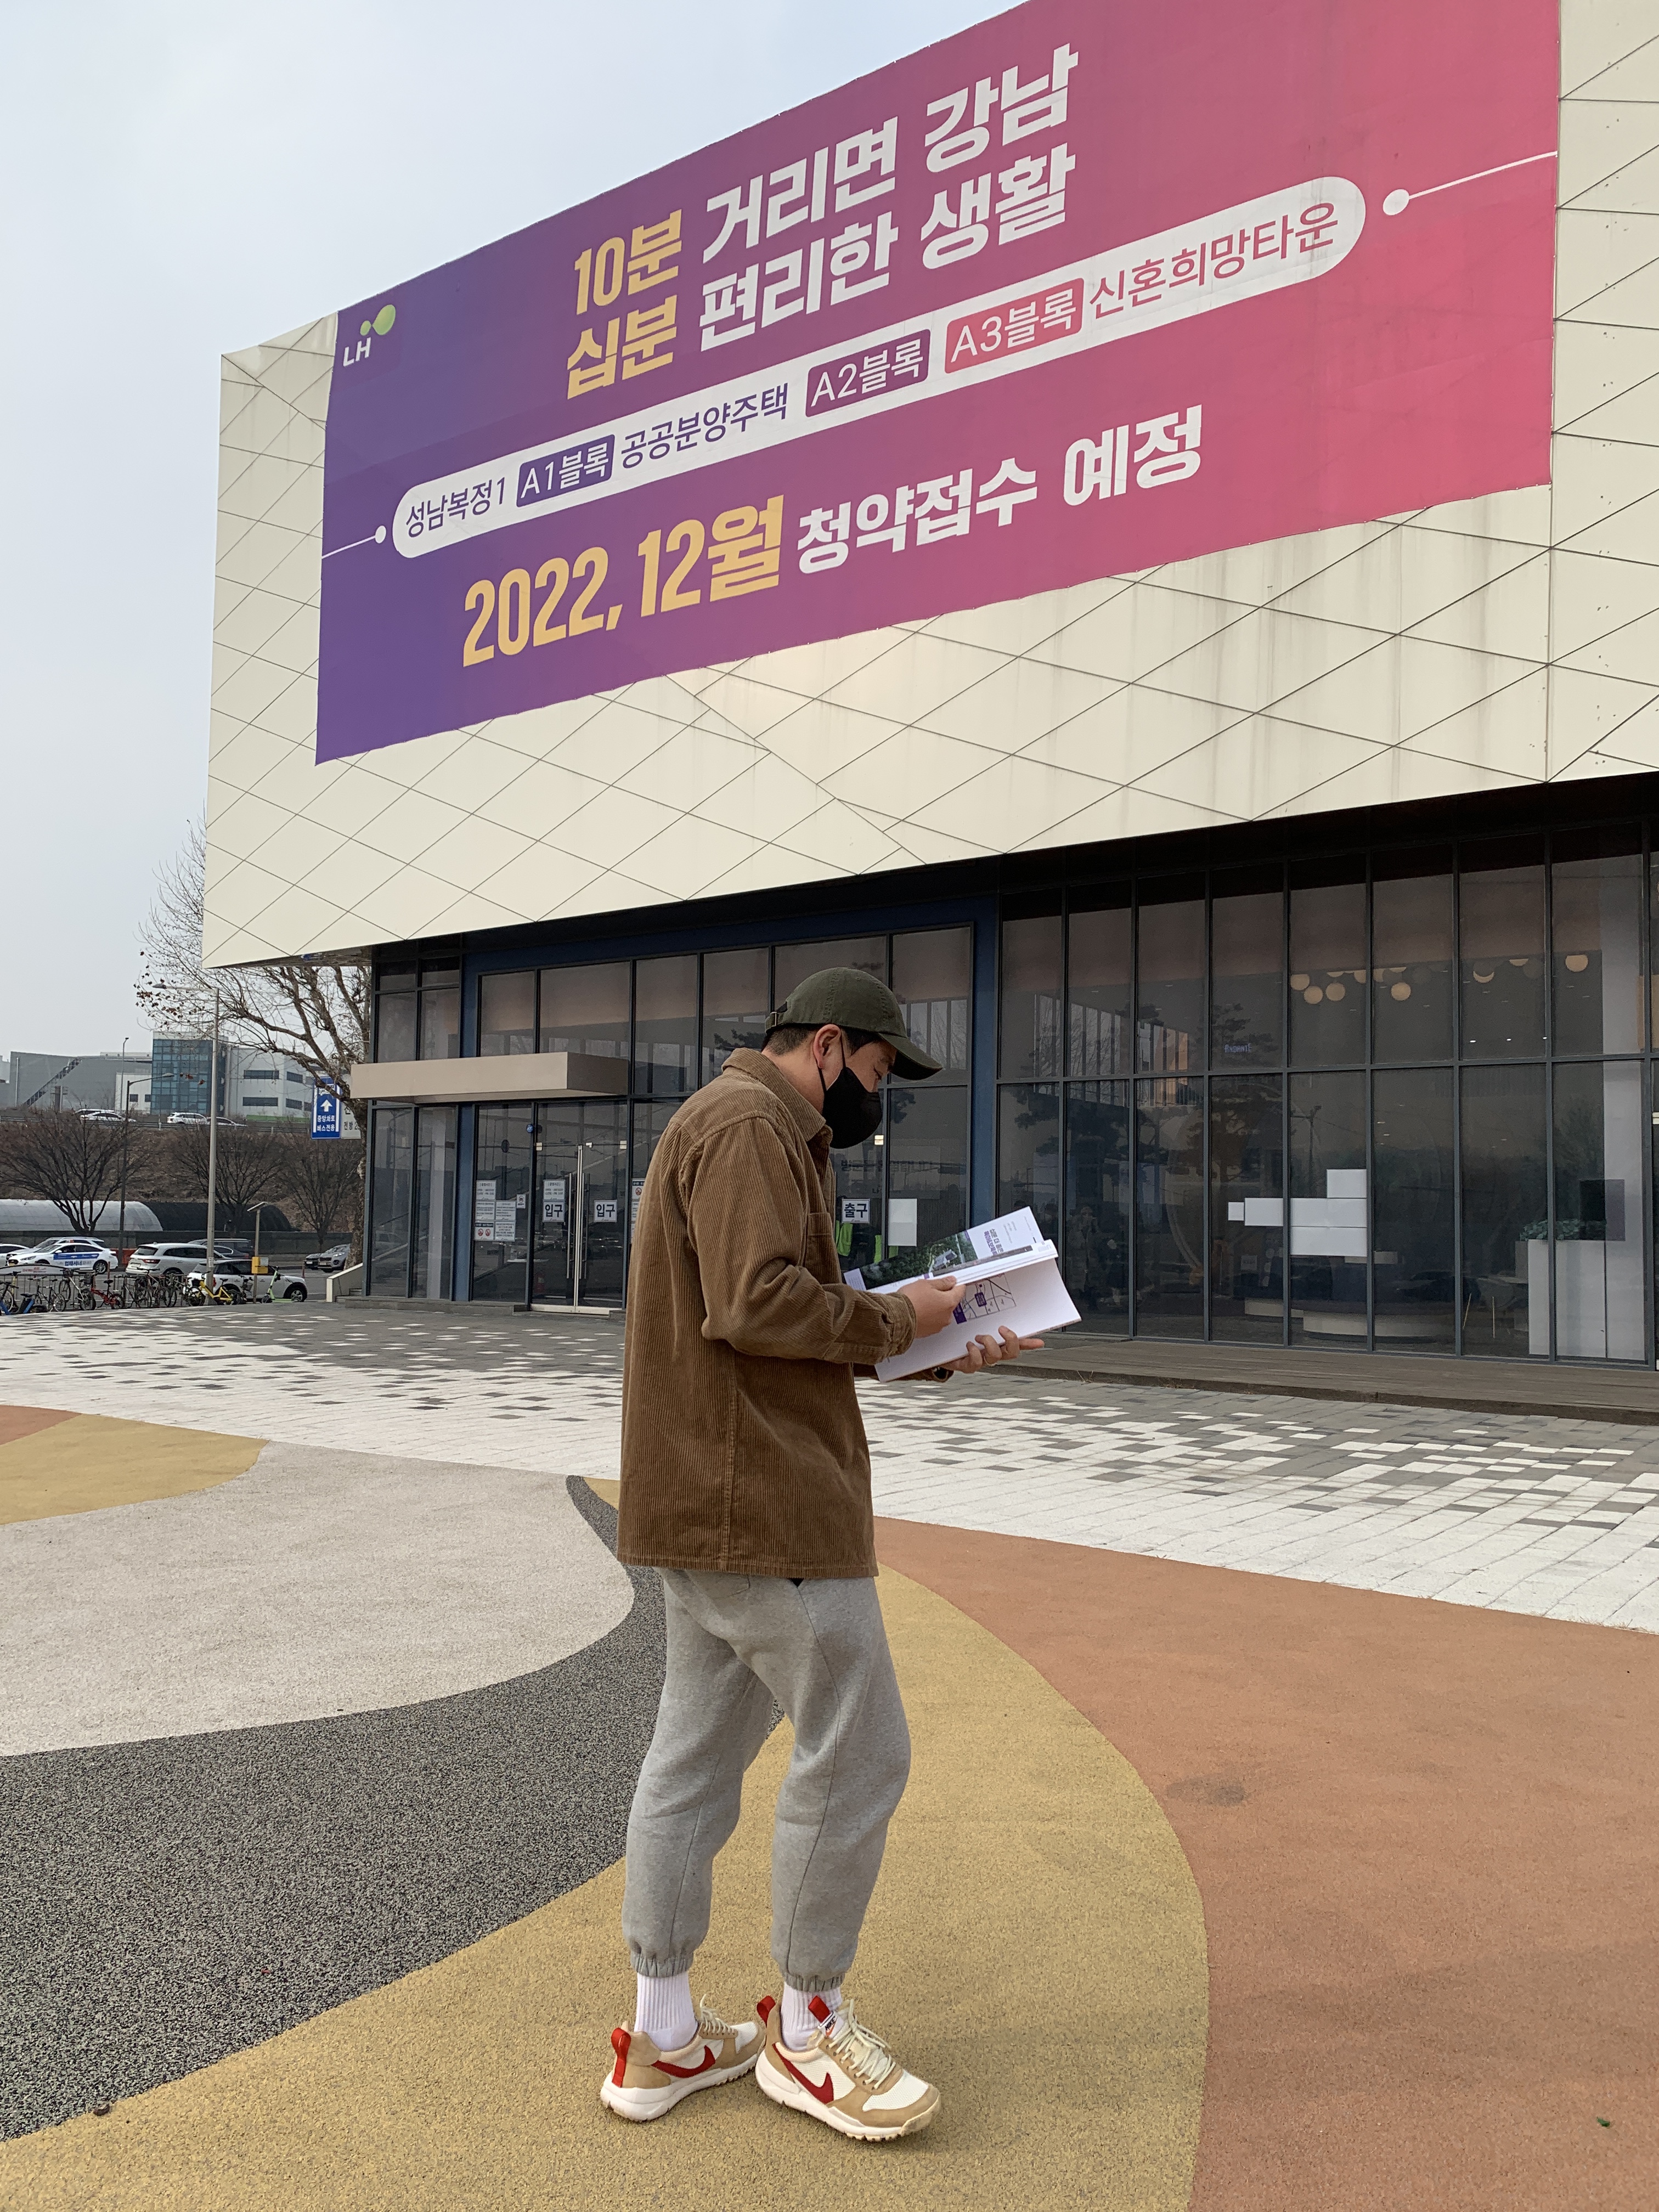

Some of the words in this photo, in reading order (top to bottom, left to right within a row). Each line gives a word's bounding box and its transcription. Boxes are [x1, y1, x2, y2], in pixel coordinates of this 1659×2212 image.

[575, 210, 681, 314] 10분
[703, 116, 898, 263] 거리면
[925, 43, 1078, 172] 강남
[567, 295, 676, 399] 십분
[699, 211, 898, 352] 편리한
[921, 143, 1075, 269] 생활
[343, 337, 371, 366] LH
[406, 477, 505, 537] 성남복정1
[521, 443, 610, 499] A1블록
[622, 383, 787, 469] 공공분양주택
[811, 339, 923, 407] A2블록
[951, 289, 1076, 363] A3블록
[1090, 203, 1338, 319] 신혼희망타운
[638, 495, 783, 617] 12월
[798, 458, 1037, 573] 청약접수
[1064, 404, 1201, 505] 예정
[343, 1121, 353, 1130] 전방
[545, 1204, 563, 1217] 입구
[596, 1204, 615, 1217] 입구
[844, 1203, 867, 1218] 출구
[825, 2016, 836, 2030] NIKE
